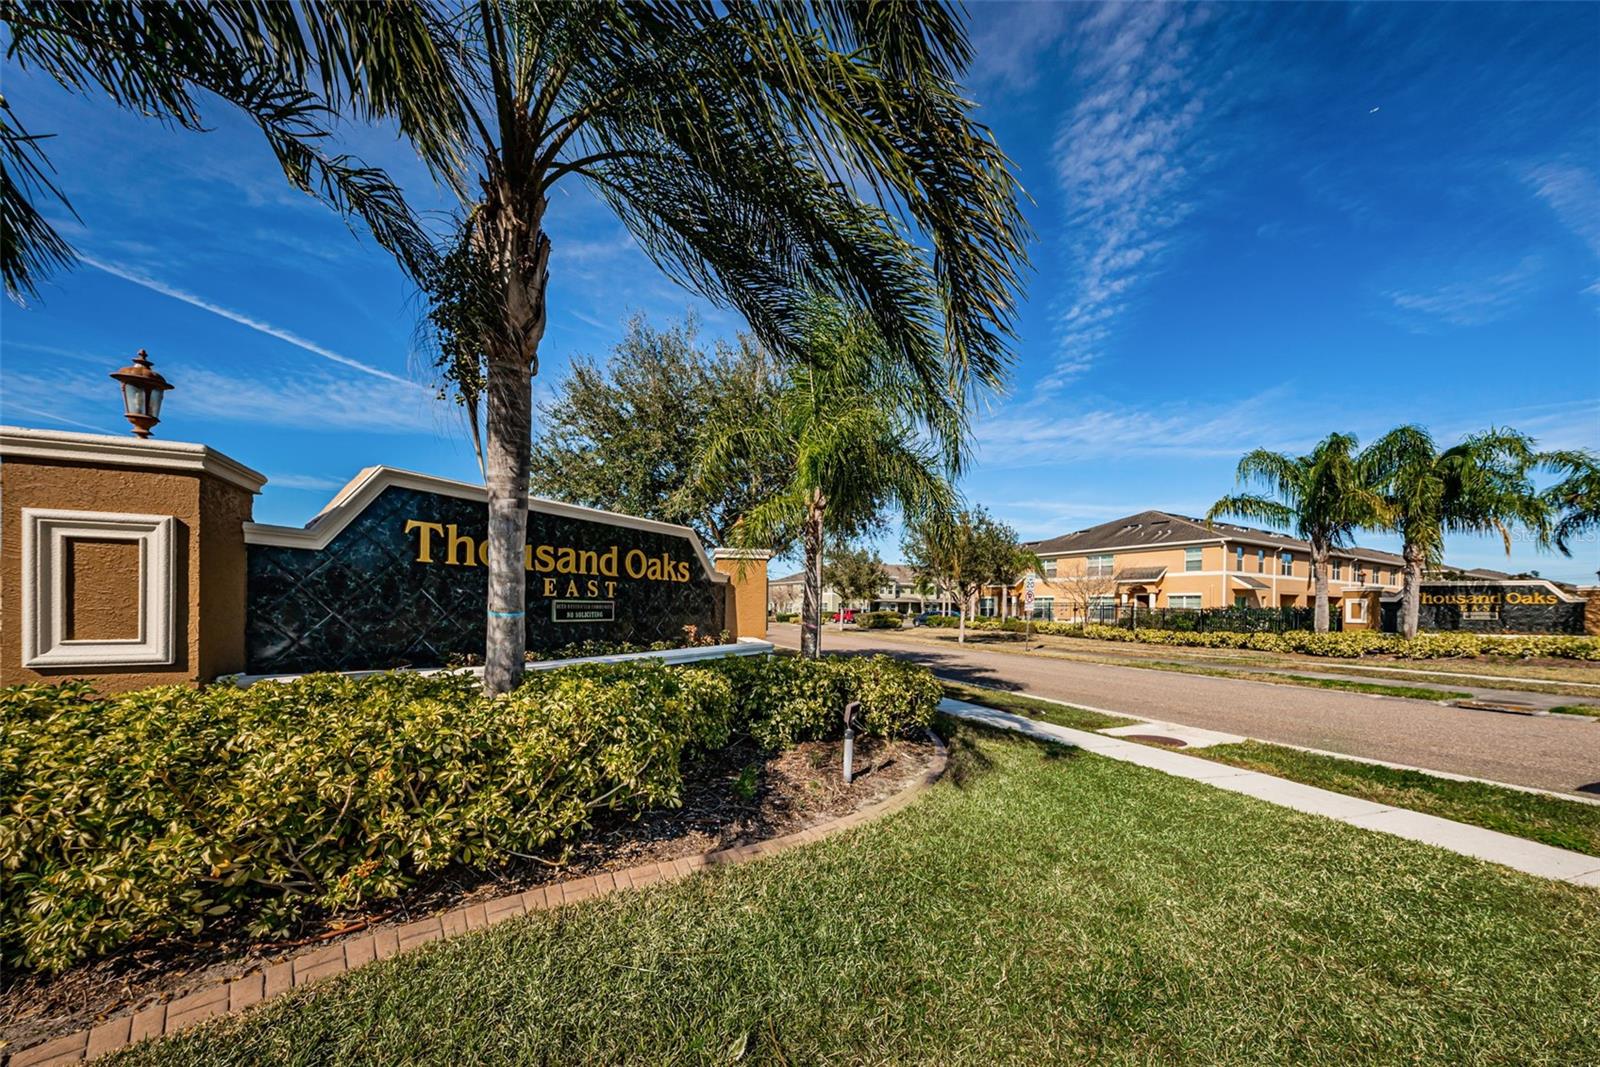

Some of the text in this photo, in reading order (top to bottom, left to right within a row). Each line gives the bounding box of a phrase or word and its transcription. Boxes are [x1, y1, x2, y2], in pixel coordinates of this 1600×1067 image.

[624, 549, 690, 583] Oaks
[542, 578, 617, 599] EAST
[1420, 592, 1558, 605] housand Oaks
